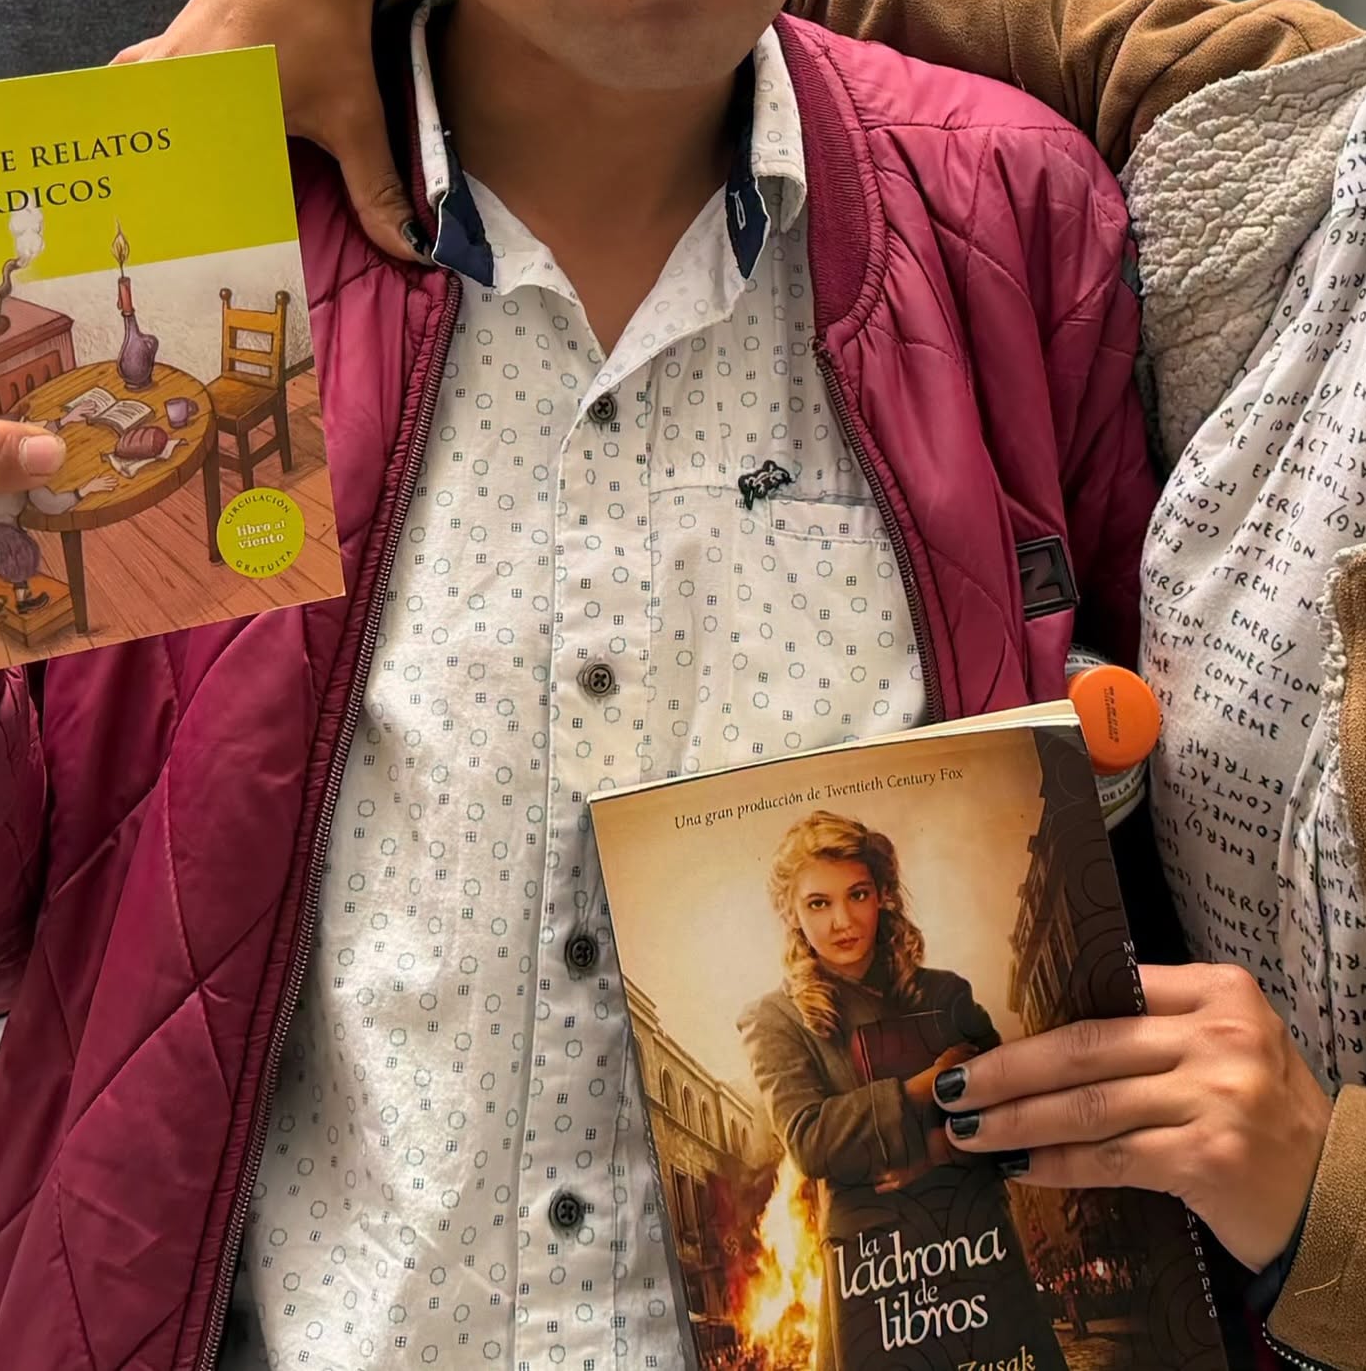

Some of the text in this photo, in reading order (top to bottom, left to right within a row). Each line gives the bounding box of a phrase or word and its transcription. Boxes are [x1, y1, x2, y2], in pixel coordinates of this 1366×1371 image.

[31, 127, 171, 168] RELATOS
[225, 495, 291, 525] CIRCULACIÓN
[236, 520, 286, 537] libro al
[236, 550, 293, 574] GRATUITA
[238, 533, 284, 549] viento
[1231, 609, 1296, 661] ENERGY
[1203, 632, 1321, 695] CONNECTION
[1205, 662, 1292, 714] CONTACT
[1193, 684, 1279, 740] EXTREME
[675, 767, 963, 829] Una gran producción de Twentieth Century Fox
[833, 1226, 1008, 1300] ladrona
[857, 1231, 882, 1260] la
[914, 1278, 940, 1306] de
[874, 1290, 990, 1352] libros
